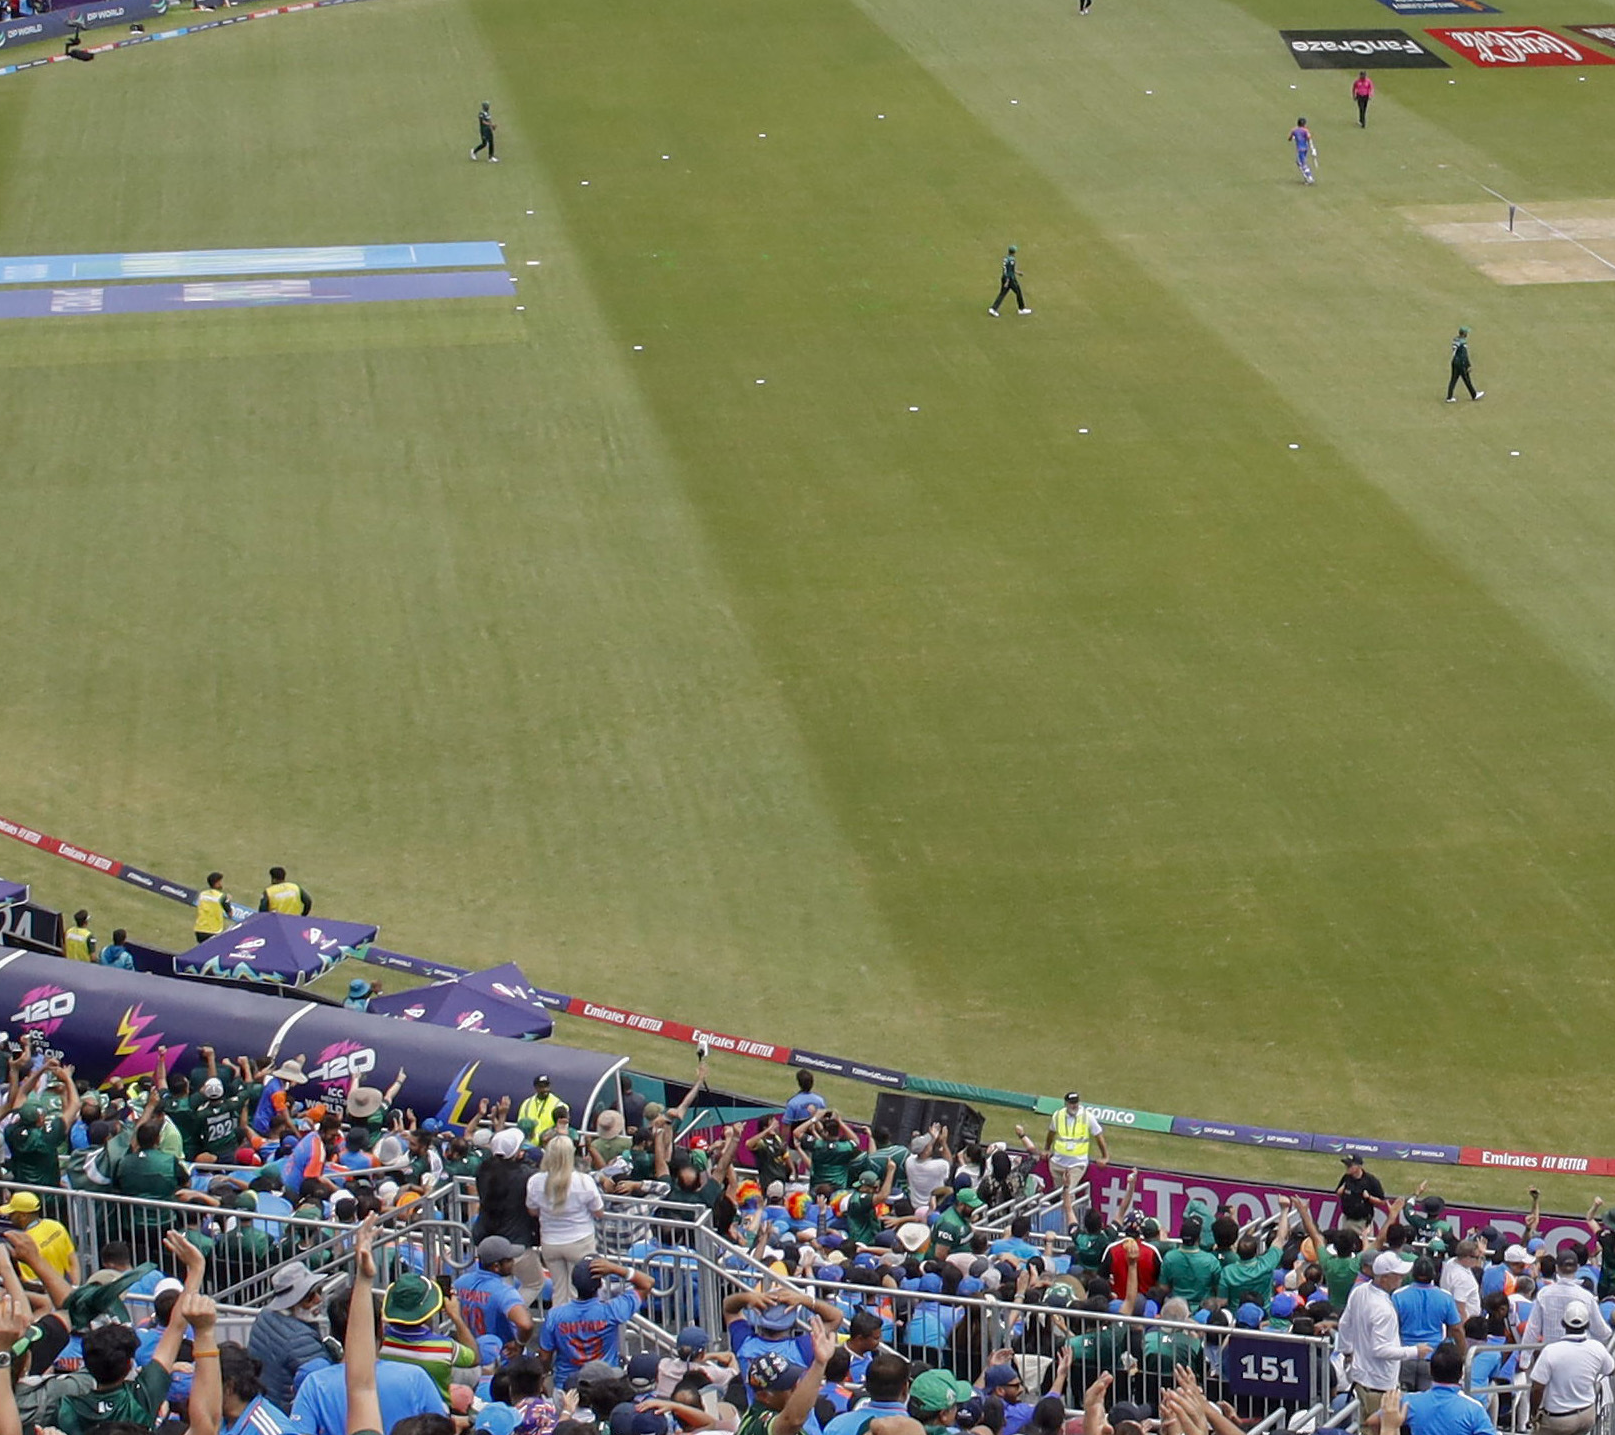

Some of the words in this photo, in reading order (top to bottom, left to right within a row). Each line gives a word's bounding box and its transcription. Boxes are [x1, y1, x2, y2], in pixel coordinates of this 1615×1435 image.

[583, 1003, 625, 1024] Emirates
[638, 1016, 663, 1032] BETTER
[692, 1029, 735, 1050] Emirates
[748, 1042, 774, 1059] BETTER
[207, 1119, 233, 1143] 292
[1482, 1150, 1538, 1169] Emirates
[1541, 1155, 1556, 1169] FLY
[1557, 1157, 1588, 1172] BETTER
[1240, 1354, 1299, 1384] 151
